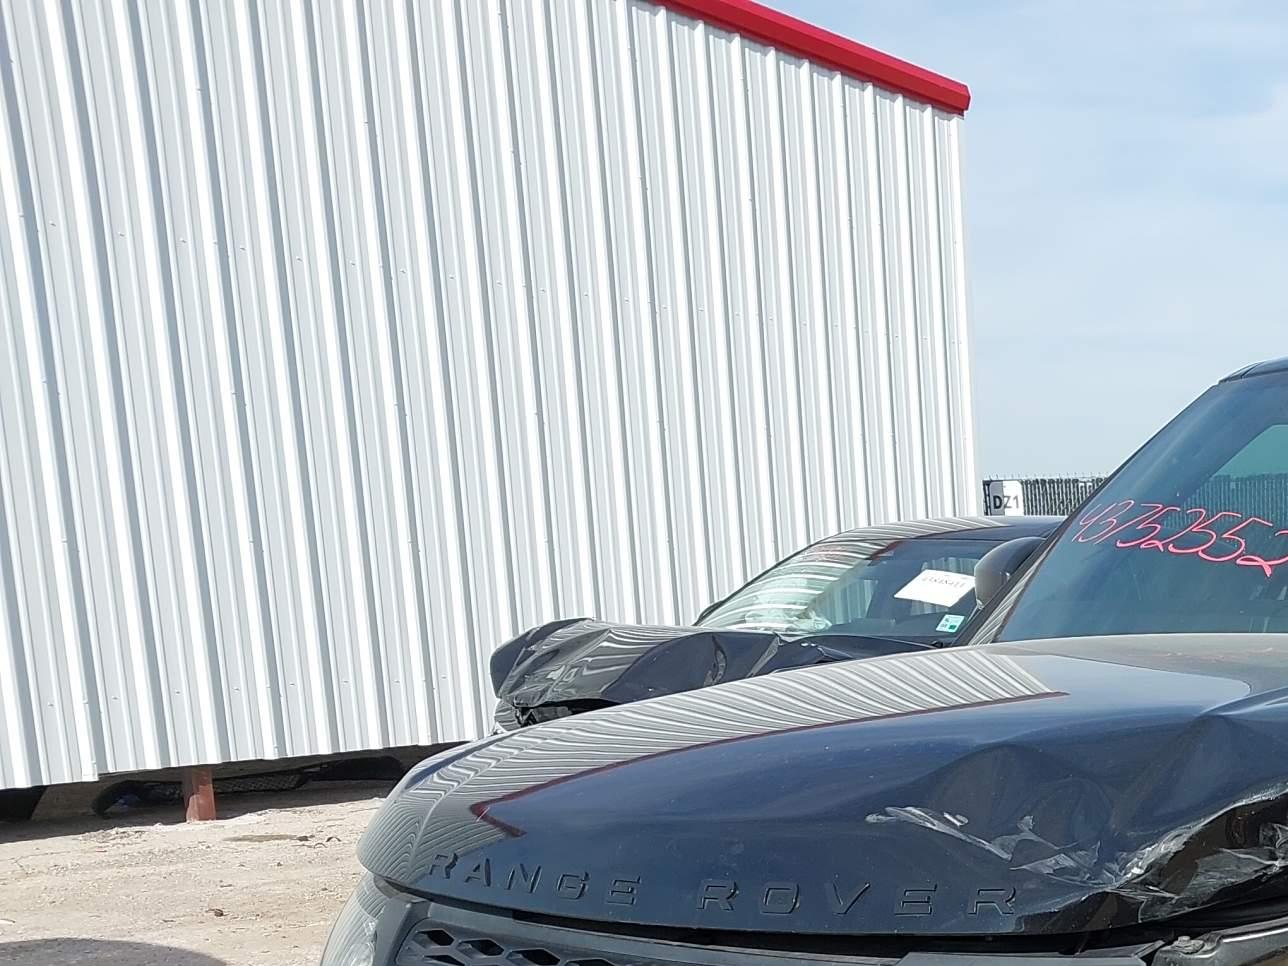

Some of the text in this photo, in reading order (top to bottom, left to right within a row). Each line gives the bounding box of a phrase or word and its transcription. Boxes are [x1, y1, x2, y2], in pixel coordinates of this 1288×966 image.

[992, 495, 1020, 510] DZ1
[427, 852, 1018, 917] RANGE ROVER
